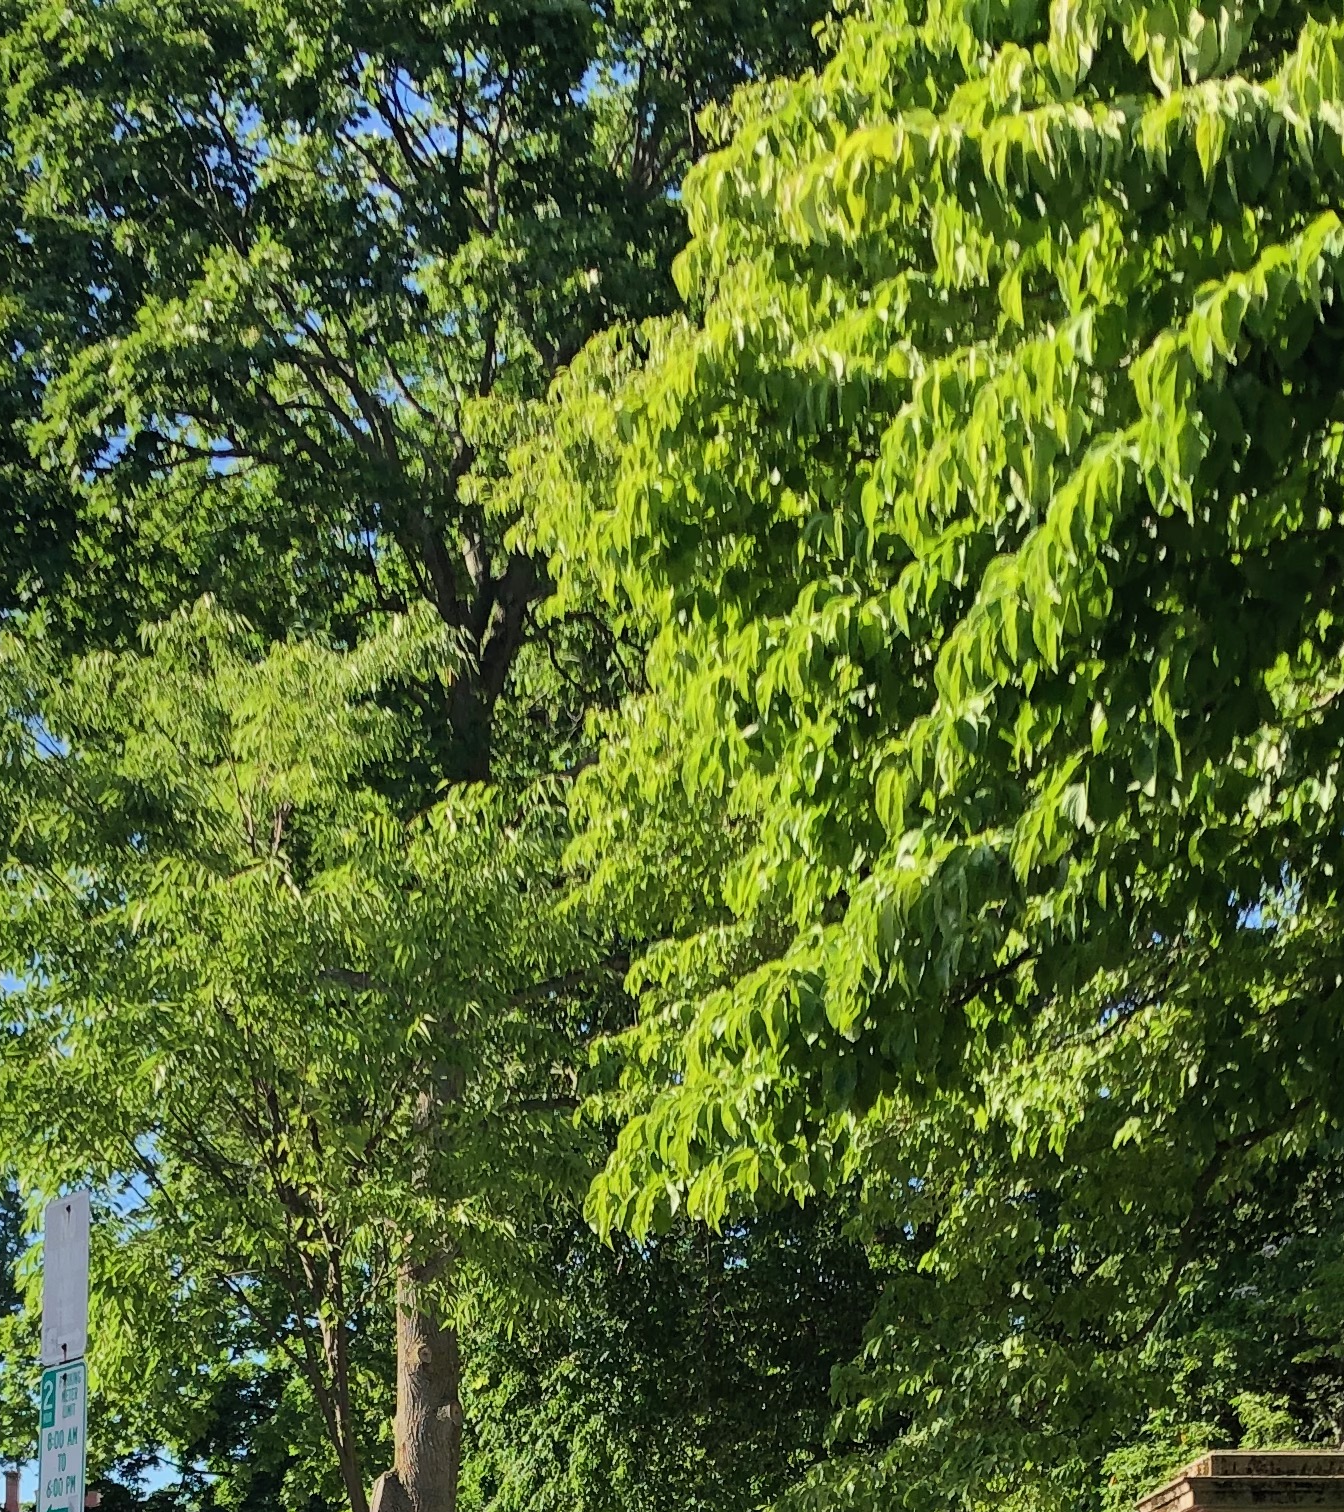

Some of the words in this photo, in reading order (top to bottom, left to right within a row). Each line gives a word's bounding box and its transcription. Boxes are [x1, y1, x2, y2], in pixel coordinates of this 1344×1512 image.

[43, 1379, 54, 1411] 2
[67, 1426, 78, 1446] AM
[58, 1453, 67, 1473] TO
[65, 1475, 76, 1495] PM
